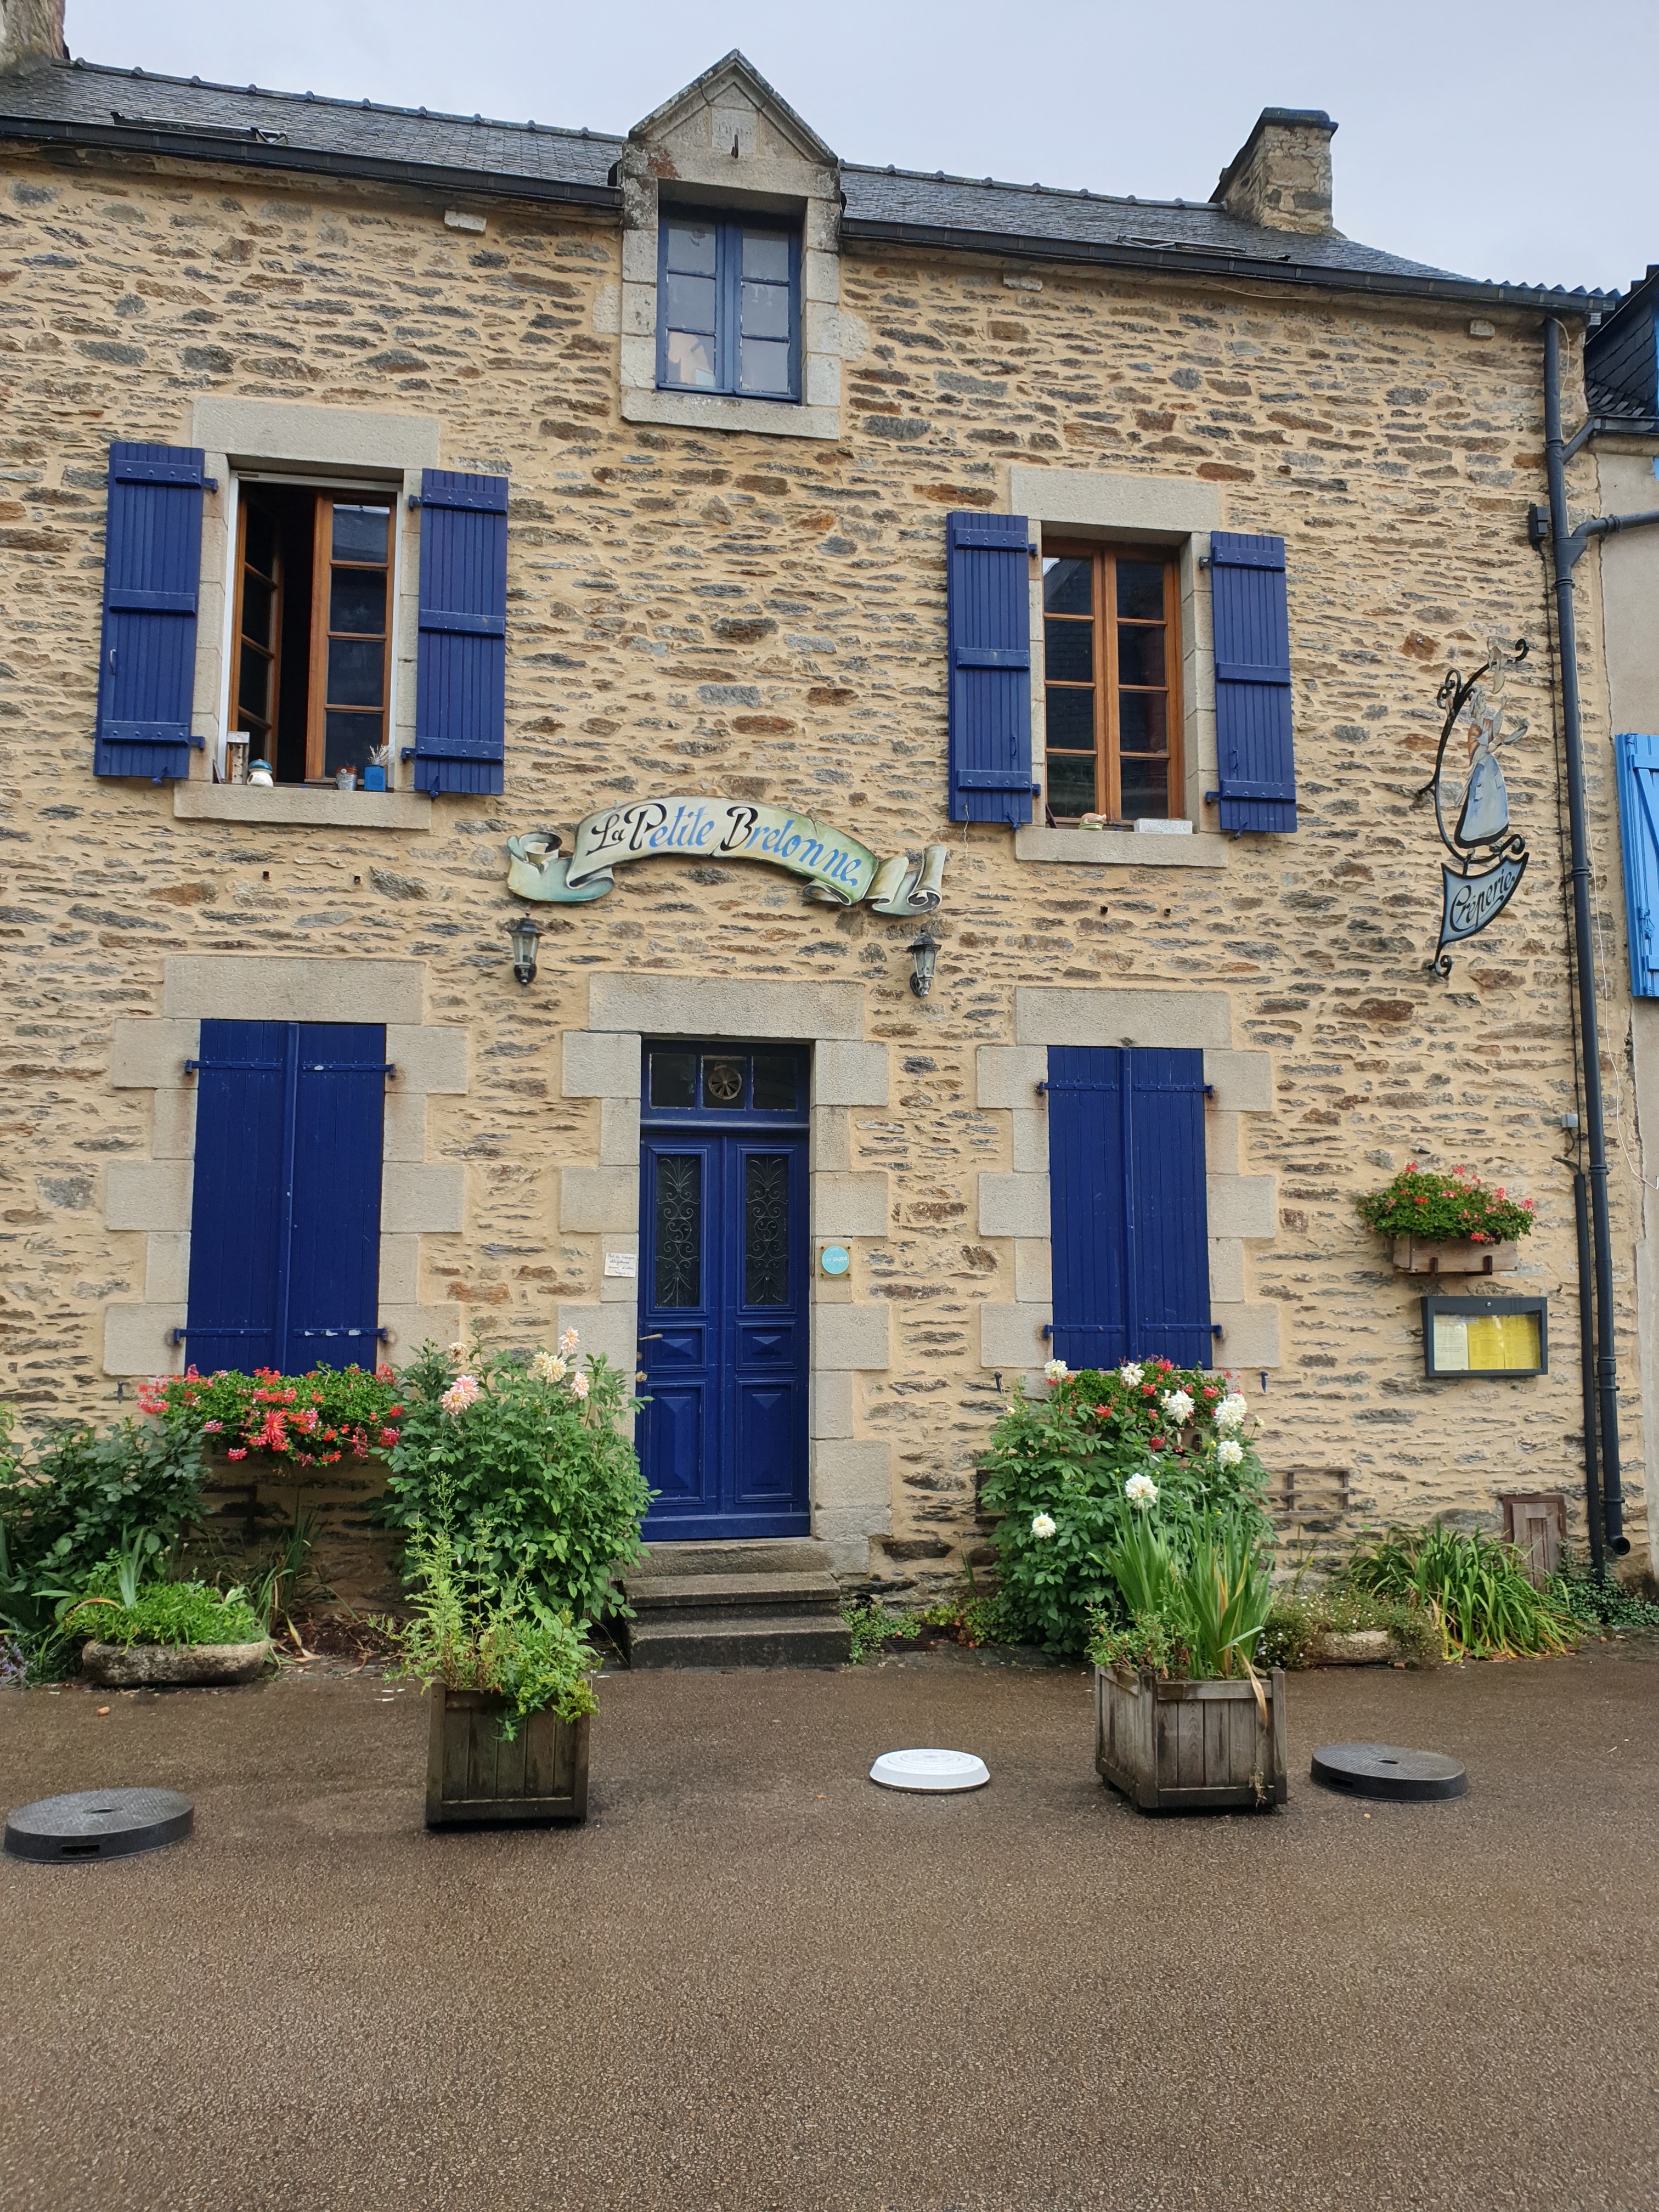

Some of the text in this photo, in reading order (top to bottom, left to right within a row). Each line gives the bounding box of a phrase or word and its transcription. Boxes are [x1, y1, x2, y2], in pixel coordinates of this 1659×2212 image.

[585, 803, 862, 887] La Petite Bretonne
